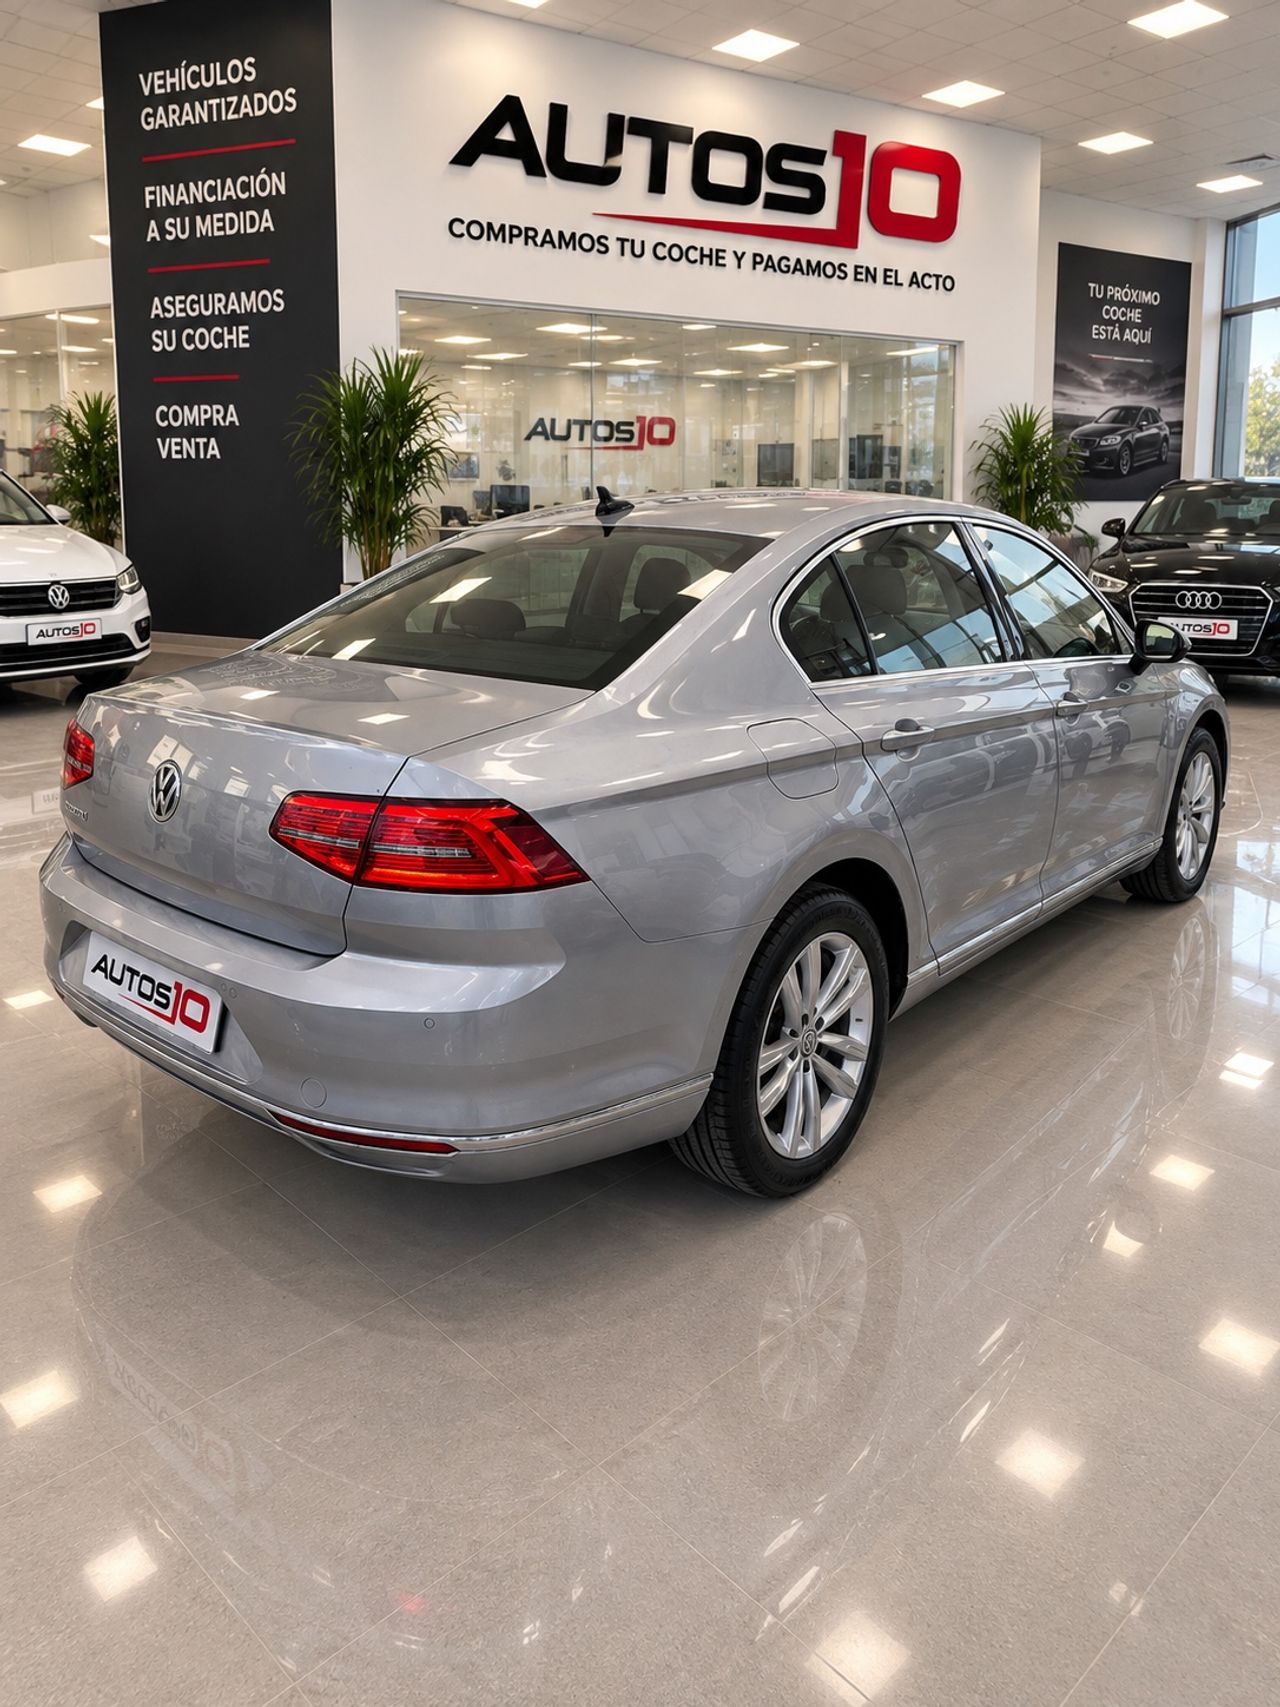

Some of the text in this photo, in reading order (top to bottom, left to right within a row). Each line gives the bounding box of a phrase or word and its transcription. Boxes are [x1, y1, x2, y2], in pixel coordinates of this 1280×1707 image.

[138, 56, 257, 96] VEHÍCULOS
[140, 87, 298, 131] GARANTIZADOS
[448, 94, 962, 249] AUTOS10
[144, 167, 286, 209] FINANCIACIÓN
[146, 208, 275, 242] A SU MEDIDA
[448, 217, 956, 292] COMPRAMOS TU COCHE Y PAGAMOS EN EL ACTO
[150, 288, 285, 319] ASEGURAMOS
[1088, 282, 1161, 306] TU PRÓXIMO
[1102, 305, 1142, 323] COCHE
[151, 325, 250, 352] SU COCHE
[1092, 323, 1153, 346] ESTÁ AQUÍ
[155, 404, 240, 427] COMPRA
[156, 437, 221, 459] VENTA
[524, 416, 676, 451] AUTOS10
[36, 622, 97, 640] AUTOS10
[1170, 622, 1231, 636] TOS10
[91, 954, 210, 1034] AUTOS10
